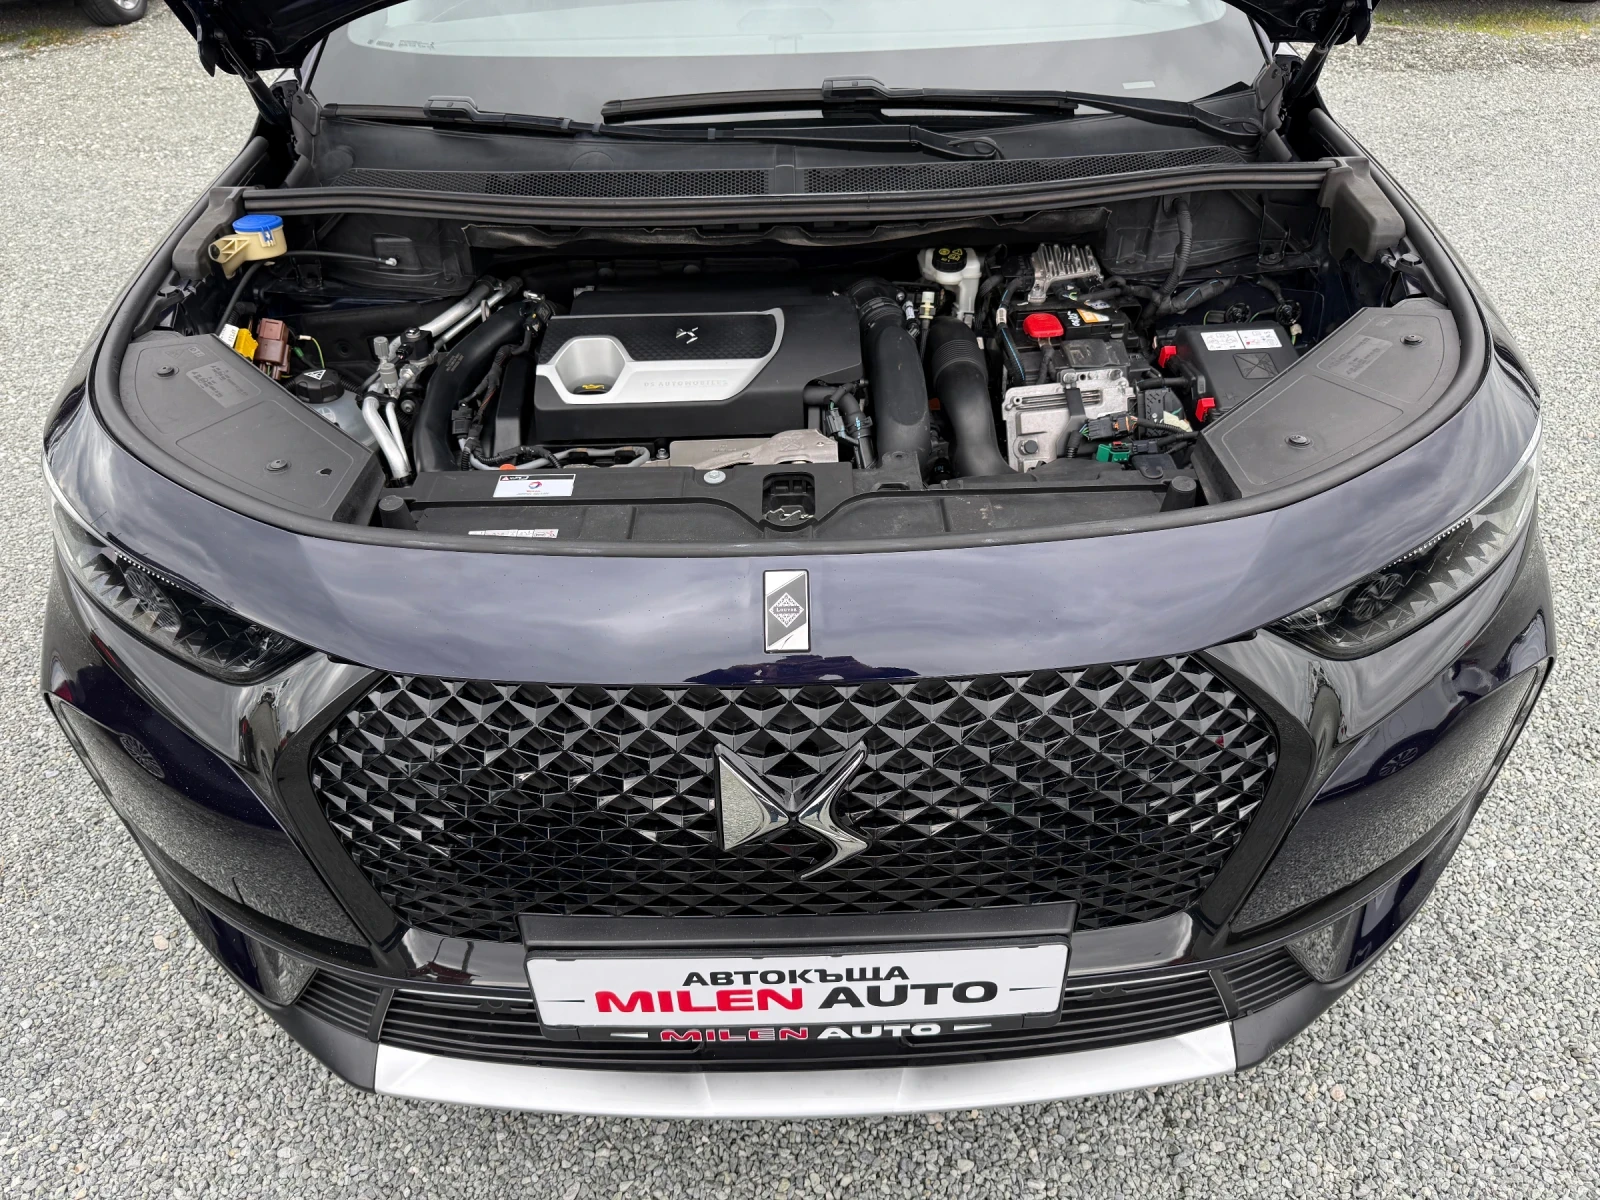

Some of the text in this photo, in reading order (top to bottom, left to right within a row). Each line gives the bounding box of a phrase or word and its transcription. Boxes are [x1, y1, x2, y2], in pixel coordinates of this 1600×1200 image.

[682, 965, 910, 987] АВТОКЪЩА
[595, 980, 998, 1013] MILEN AUTO
[660, 1022, 941, 1042] MILEN AUTO
